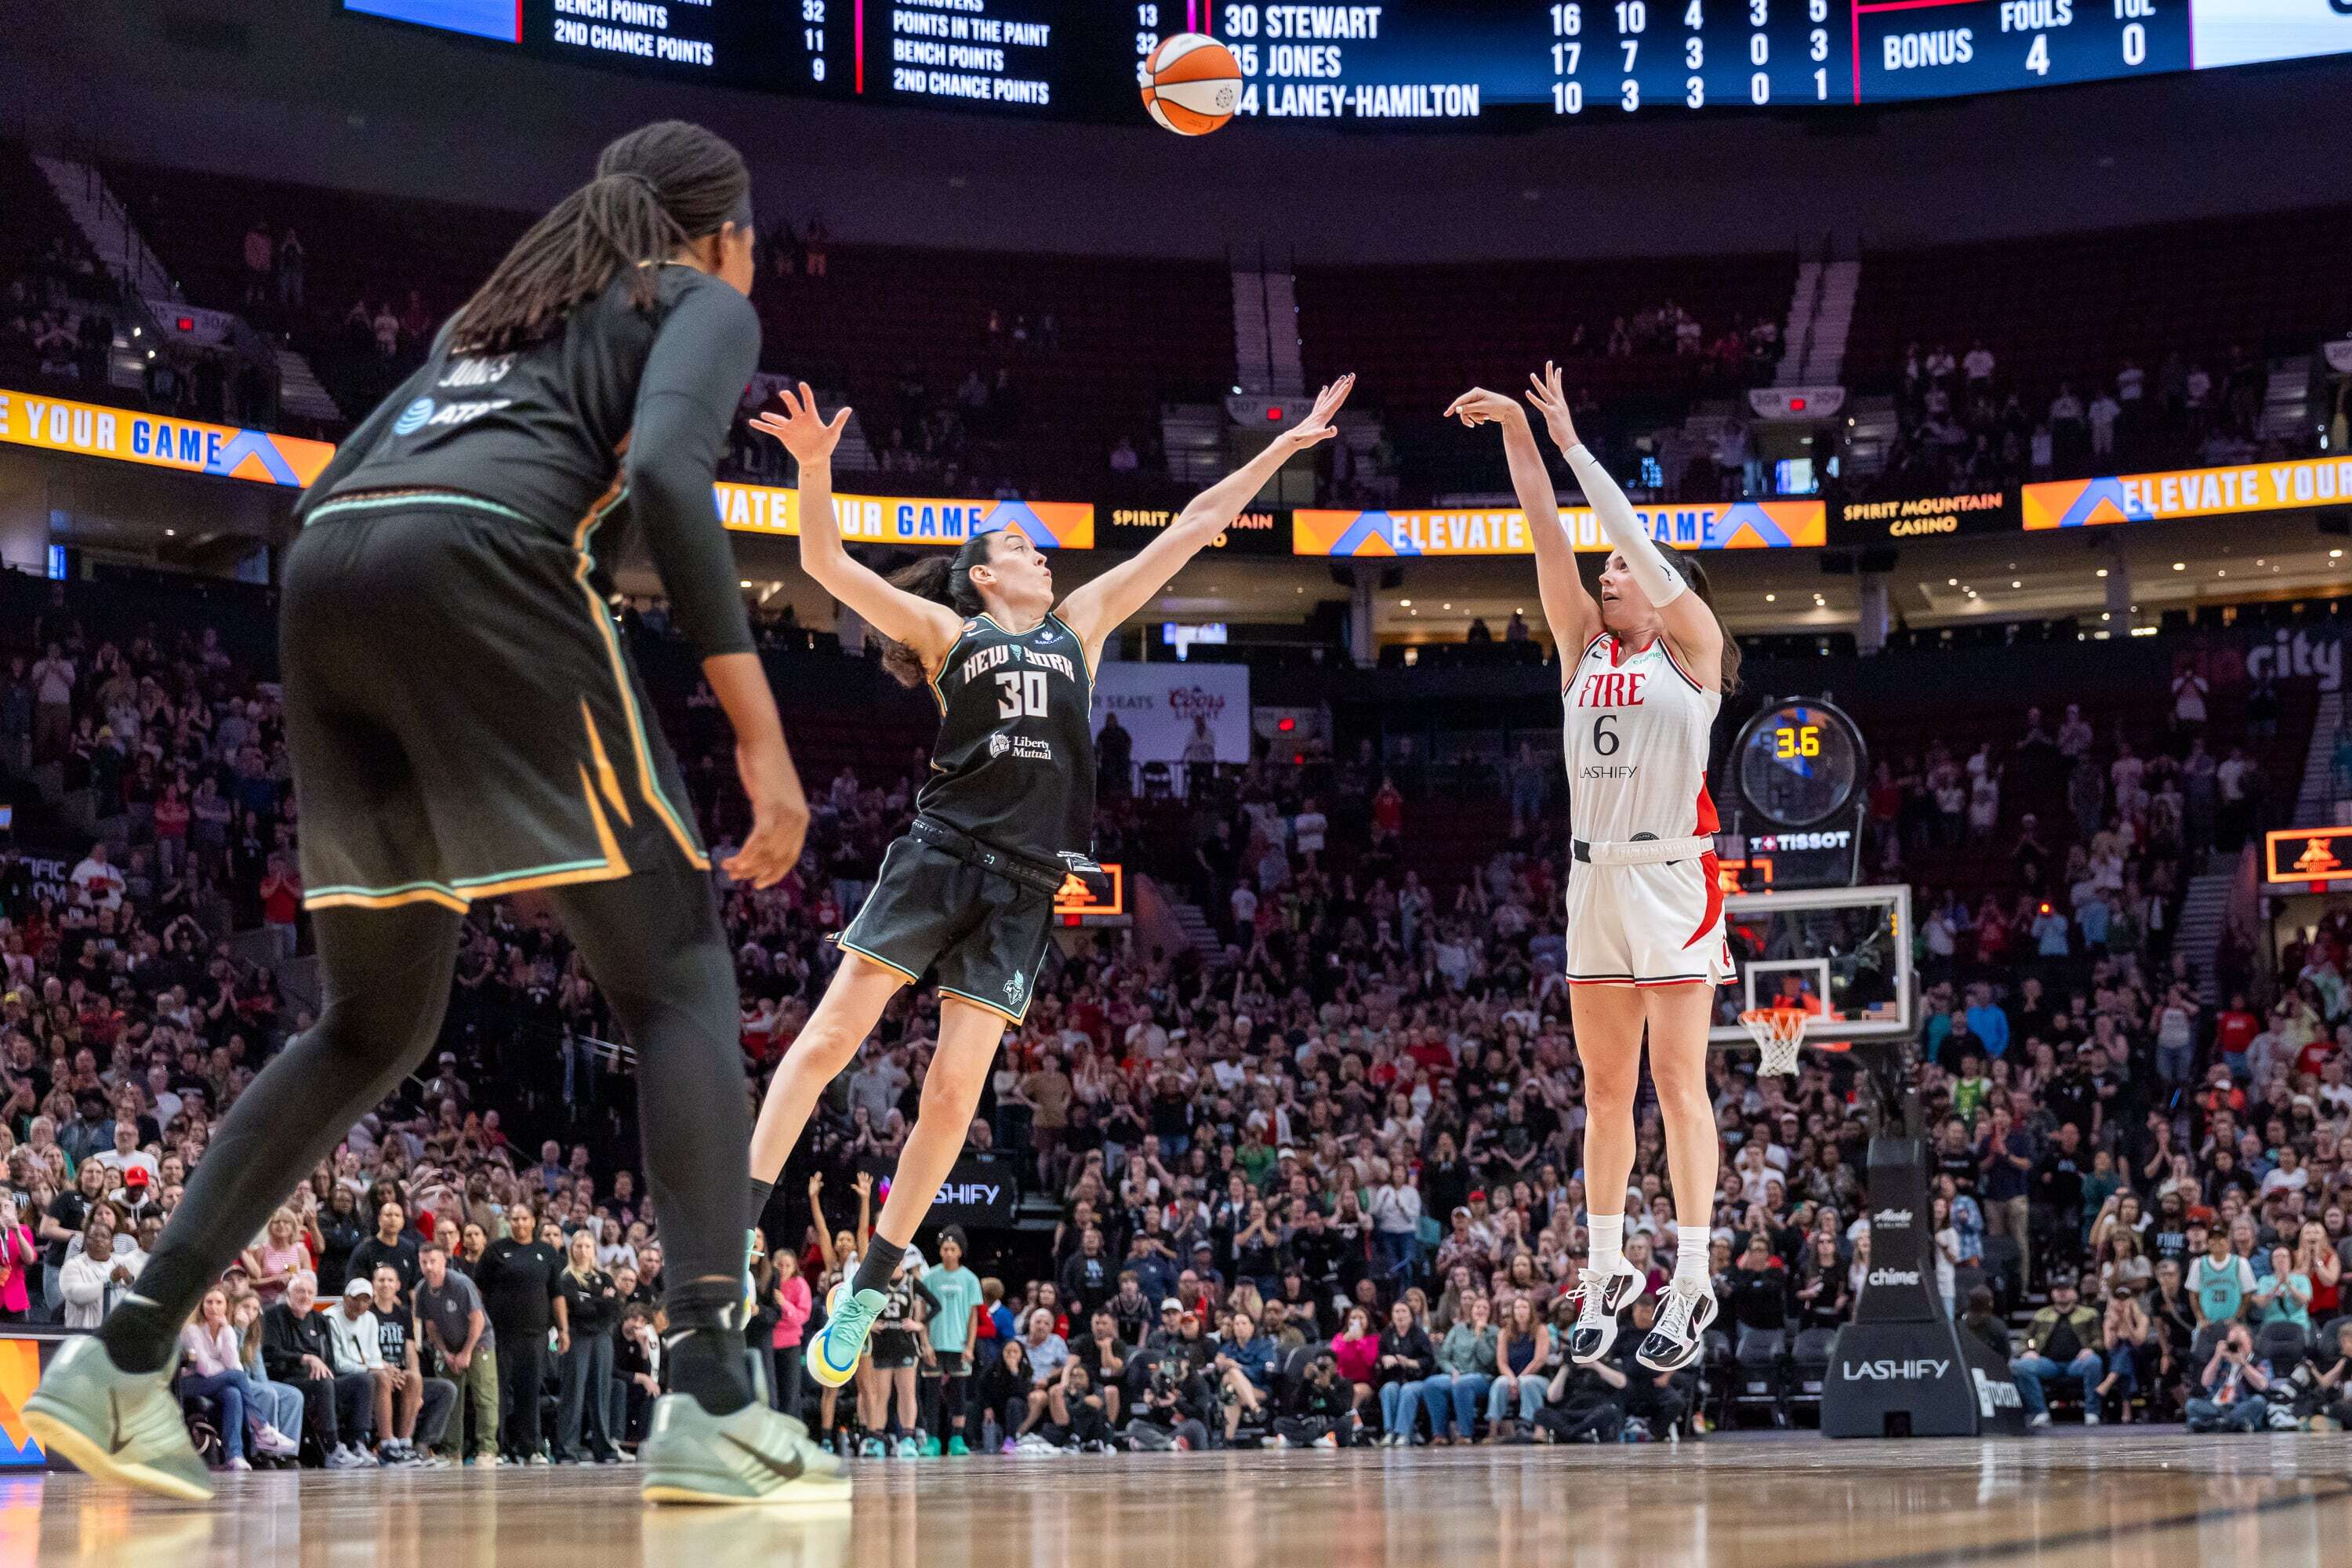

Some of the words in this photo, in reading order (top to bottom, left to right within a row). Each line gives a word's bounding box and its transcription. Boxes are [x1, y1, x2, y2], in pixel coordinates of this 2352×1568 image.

[554, 0, 608, 19] BENCH
[611, 0, 668, 29] POINTS
[803, 0, 825, 22] 32
[1138, 4, 1158, 27] 13
[1225, 4, 1258, 38] 30
[1266, 4, 1381, 38] STEWART
[1551, 3, 1581, 36] 16
[1615, 0, 1646, 34] 10
[1684, 0, 1704, 30] 4
[1750, 0, 1768, 27] 3
[2001, 0, 2073, 32] FOULS
[554, 18, 588, 45] 2ND
[590, 24, 655, 57] CHANCE
[657, 35, 714, 66] POINTS
[804, 29, 824, 51] 11
[893, 9, 949, 38] POINTS
[950, 16, 969, 39] IN
[970, 17, 1002, 42] THE
[1004, 21, 1051, 47] PAINT
[1137, 32, 1158, 54] 32
[2122, 22, 2146, 66] 0
[893, 38, 946, 66] BENCH
[949, 45, 1004, 72] POINTS
[1266, 45, 1342, 78] JONES
[1551, 42, 1581, 75] 17
[1620, 40, 1639, 72] 7
[1686, 36, 1704, 70] 3
[1750, 33, 1769, 66] 0
[1809, 28, 1828, 61] 3
[1882, 27, 1973, 71] BONUS
[2025, 34, 2051, 76] 4
[812, 58, 825, 82] 9
[893, 67, 927, 93] 2ND
[928, 71, 992, 99] CHANCE
[993, 78, 1050, 105] POINTS
[1234, 84, 1259, 116] 4
[1267, 84, 1480, 117] LANEY-HAMILTON
[1552, 82, 1583, 114] 10
[1621, 78, 1639, 112] 3
[1686, 75, 1704, 109] 3
[1751, 71, 1769, 105] 0
[1813, 67, 1828, 100] 1
[25, 401, 116, 452] YOUR
[132, 420, 222, 466] GAME
[2123, 470, 2259, 514] ELEVATE
[2270, 463, 2352, 503] YOUR
[715, 487, 787, 528] VATE
[832, 498, 882, 536] UR
[898, 504, 982, 538] GAME
[1112, 510, 1170, 527] SPIRIT
[1843, 502, 1900, 521] SPIRIT
[1900, 492, 2003, 517] MOUNTAIN
[1392, 514, 1523, 549] ELEVATE
[1889, 515, 1958, 536] CASINO
[963, 644, 1010, 684] NEW
[1023, 645, 1076, 684] YORK
[2246, 628, 2343, 691] city
[995, 670, 1048, 720] 30
[1107, 695, 1154, 710] SEATS
[1578, 673, 1646, 708] FIRE
[1014, 735, 1050, 752] Liberty
[1593, 714, 1620, 756] 6
[1776, 726, 1820, 758] 3.6
[1011, 747, 1052, 760] Mutual
[1579, 765, 1638, 779] LASHIFY
[1777, 830, 1850, 851] TISSOT
[932, 1182, 1000, 1205] SHIFY
[1868, 1267, 1919, 1286] chime
[1843, 1359, 1950, 1381] LASHIFY
